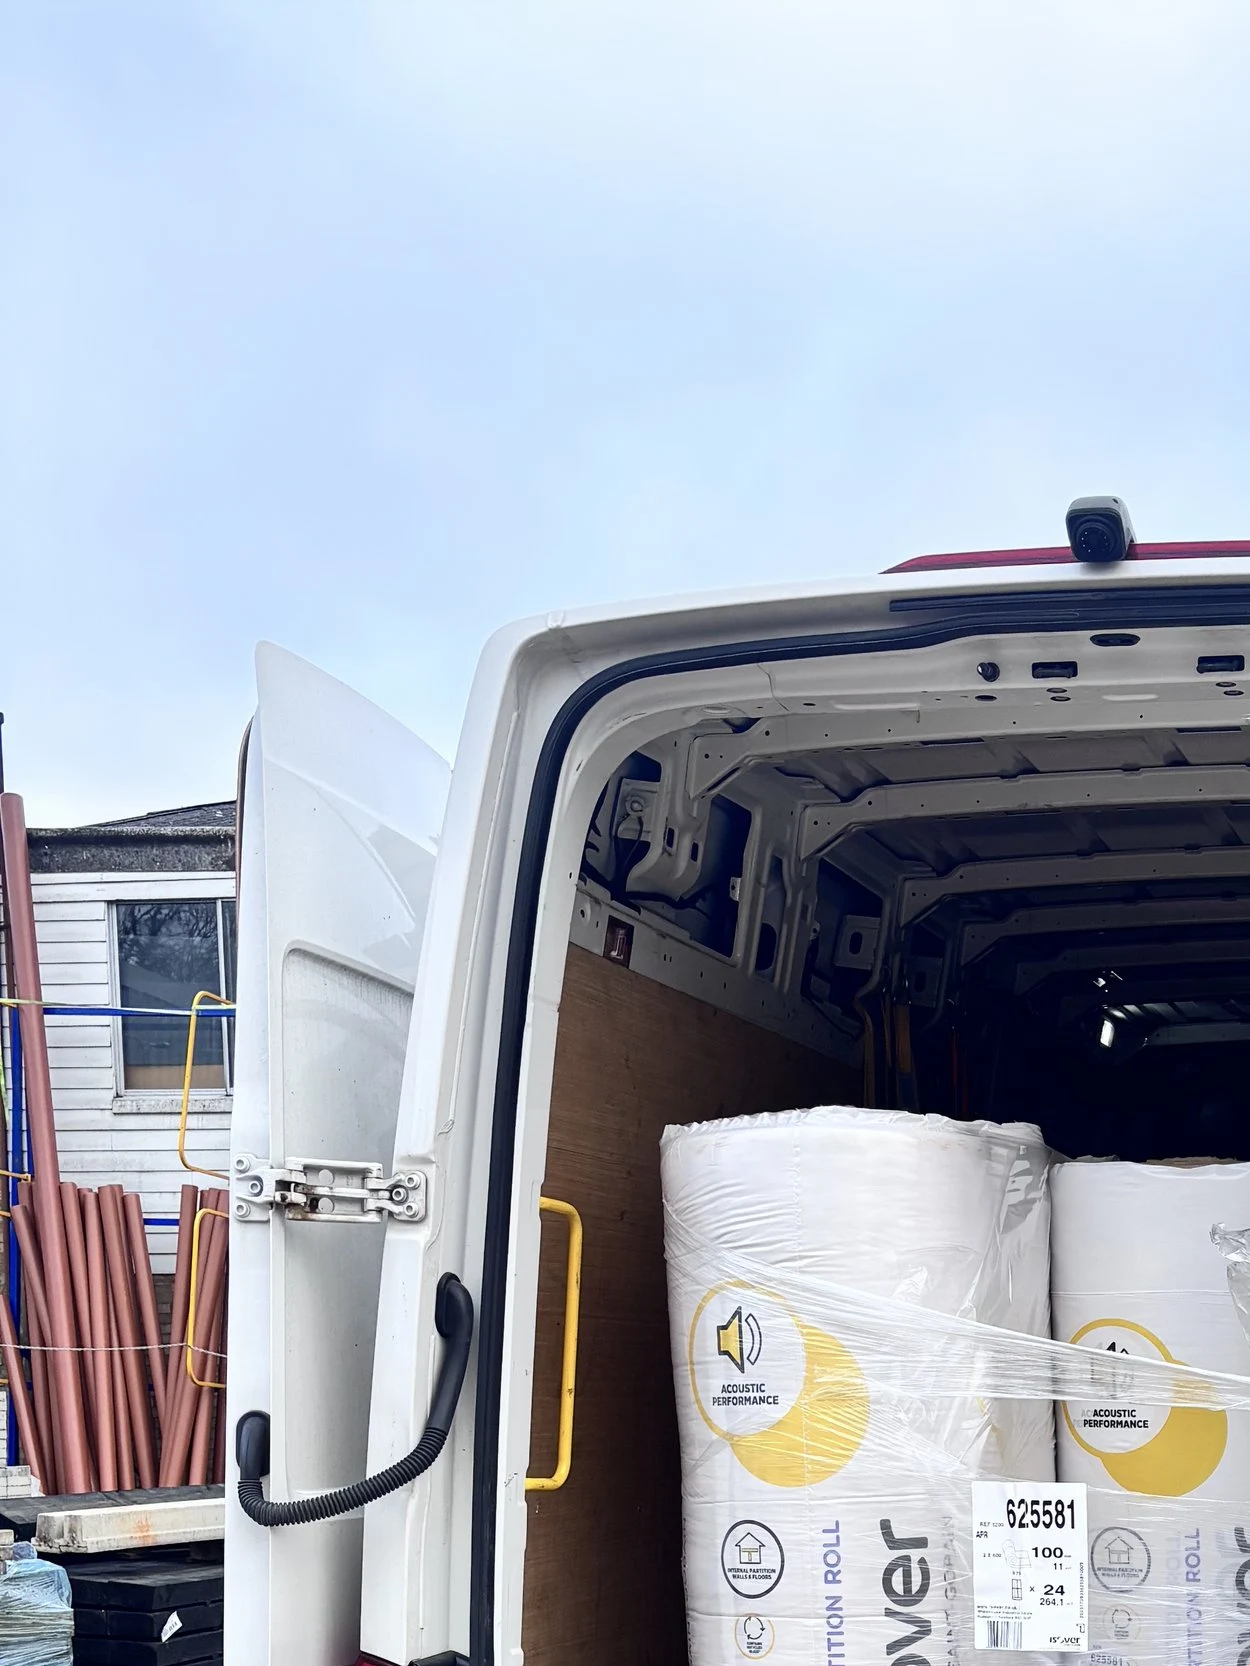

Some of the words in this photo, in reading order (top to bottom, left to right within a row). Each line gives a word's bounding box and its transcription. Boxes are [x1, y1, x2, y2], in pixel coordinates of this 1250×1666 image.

[721, 1383, 766, 1394] ACOUSTIC
[712, 1395, 779, 1406] PERFORMANCE
[1093, 1409, 1136, 1418] ACOUSTIC
[1083, 1419, 1149, 1429] PERFORMANCE
[1006, 1498, 1075, 1529] 625581
[822, 1520, 843, 1585] ROLL
[1031, 1547, 1063, 1558] 100
[1184, 1528, 1201, 1582] ROLL
[1043, 1584, 1065, 1596] 24
[1040, 1598, 1064, 1606] 264.1
